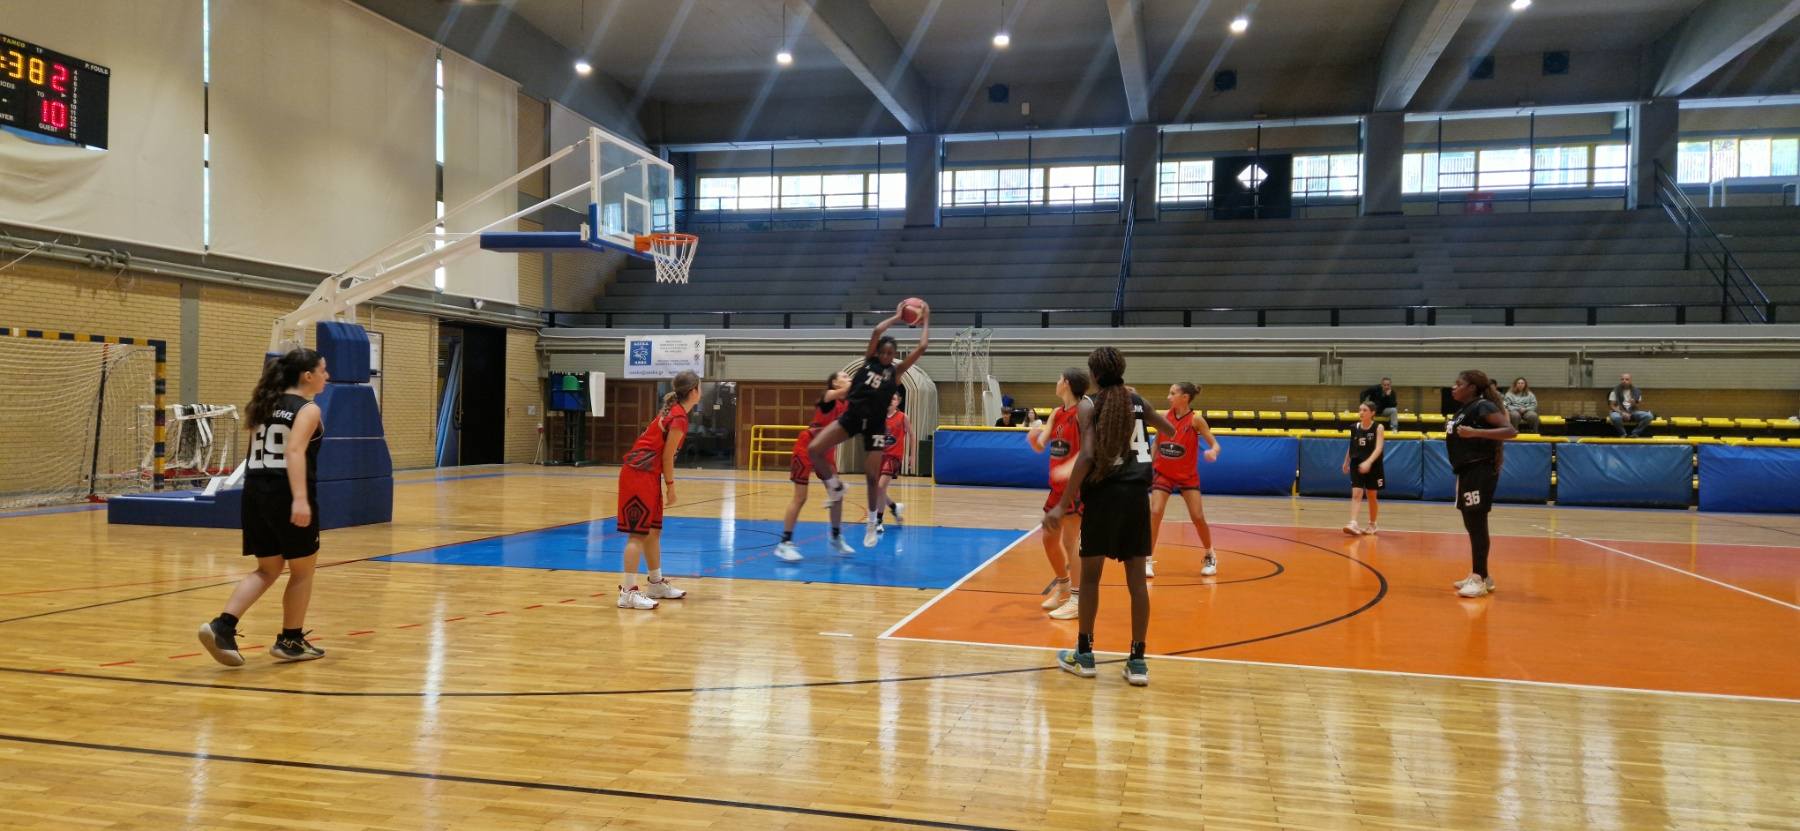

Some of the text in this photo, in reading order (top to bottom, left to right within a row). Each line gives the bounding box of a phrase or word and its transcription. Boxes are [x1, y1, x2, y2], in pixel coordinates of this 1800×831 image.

[52, 63, 69, 92] 2
[42, 100, 67, 128] 10
[39, 123, 58, 132] GUEST
[248, 423, 292, 469] 69
[872, 434, 885, 447] 75
[1463, 490, 1481, 507] 36
